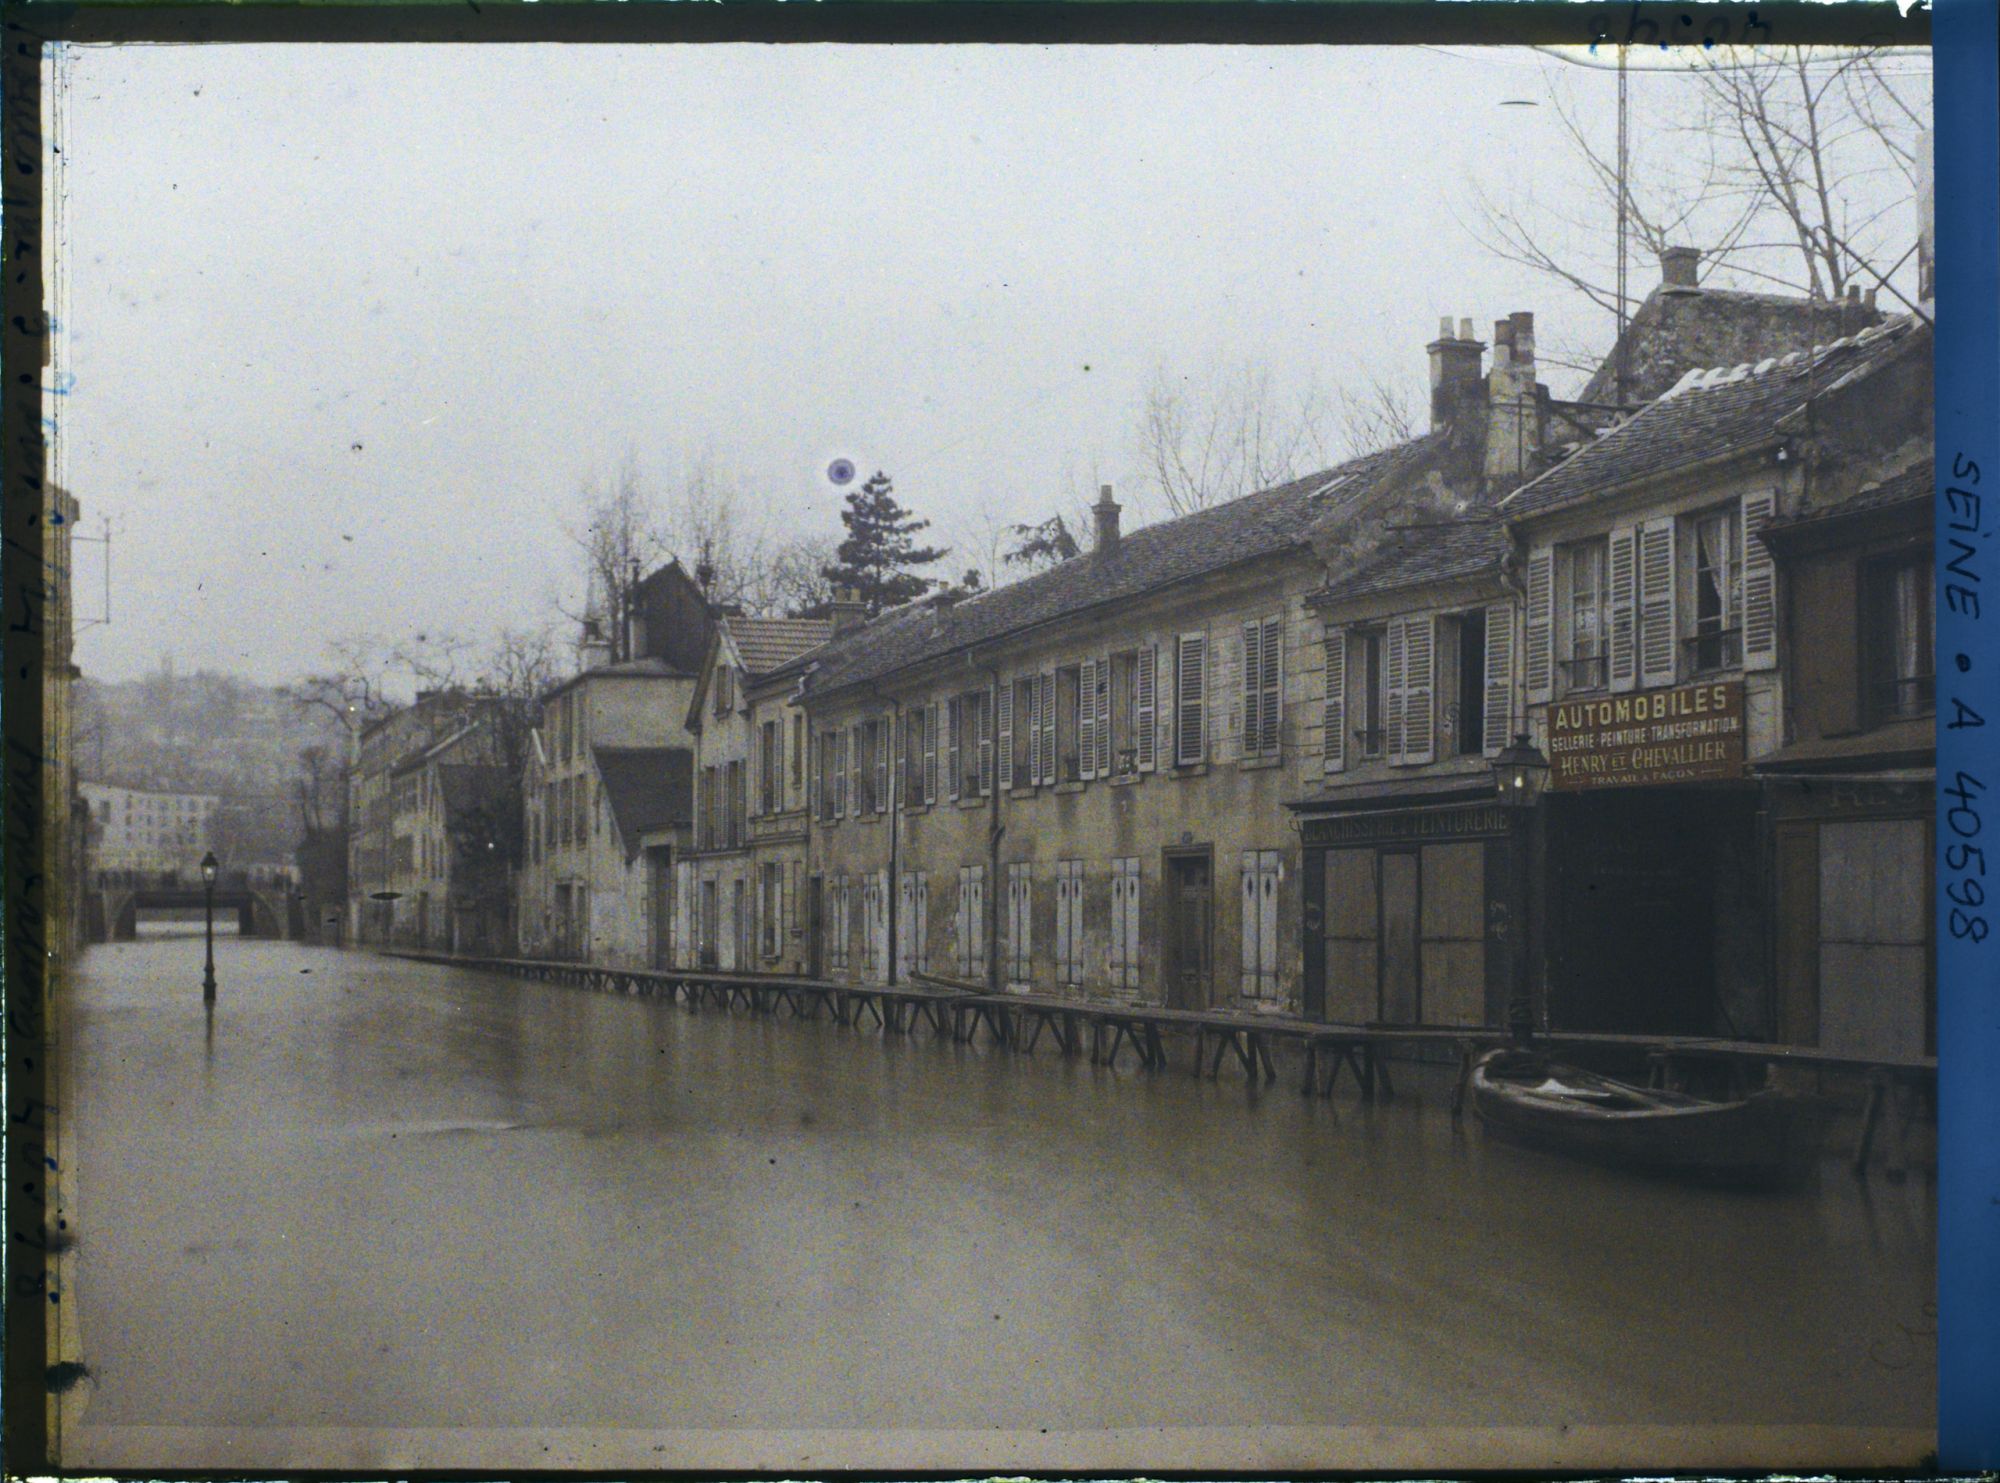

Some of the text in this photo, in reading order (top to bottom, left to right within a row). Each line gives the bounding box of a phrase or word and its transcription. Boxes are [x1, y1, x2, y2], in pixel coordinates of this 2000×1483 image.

[1555, 685, 1727, 730] AUTOMOBILES
[1947, 698, 1985, 730] A
[1560, 754, 1609, 777] HENRY
[1632, 740, 1727, 770] CHEVALLIER
[1944, 770, 1988, 944] 40598
